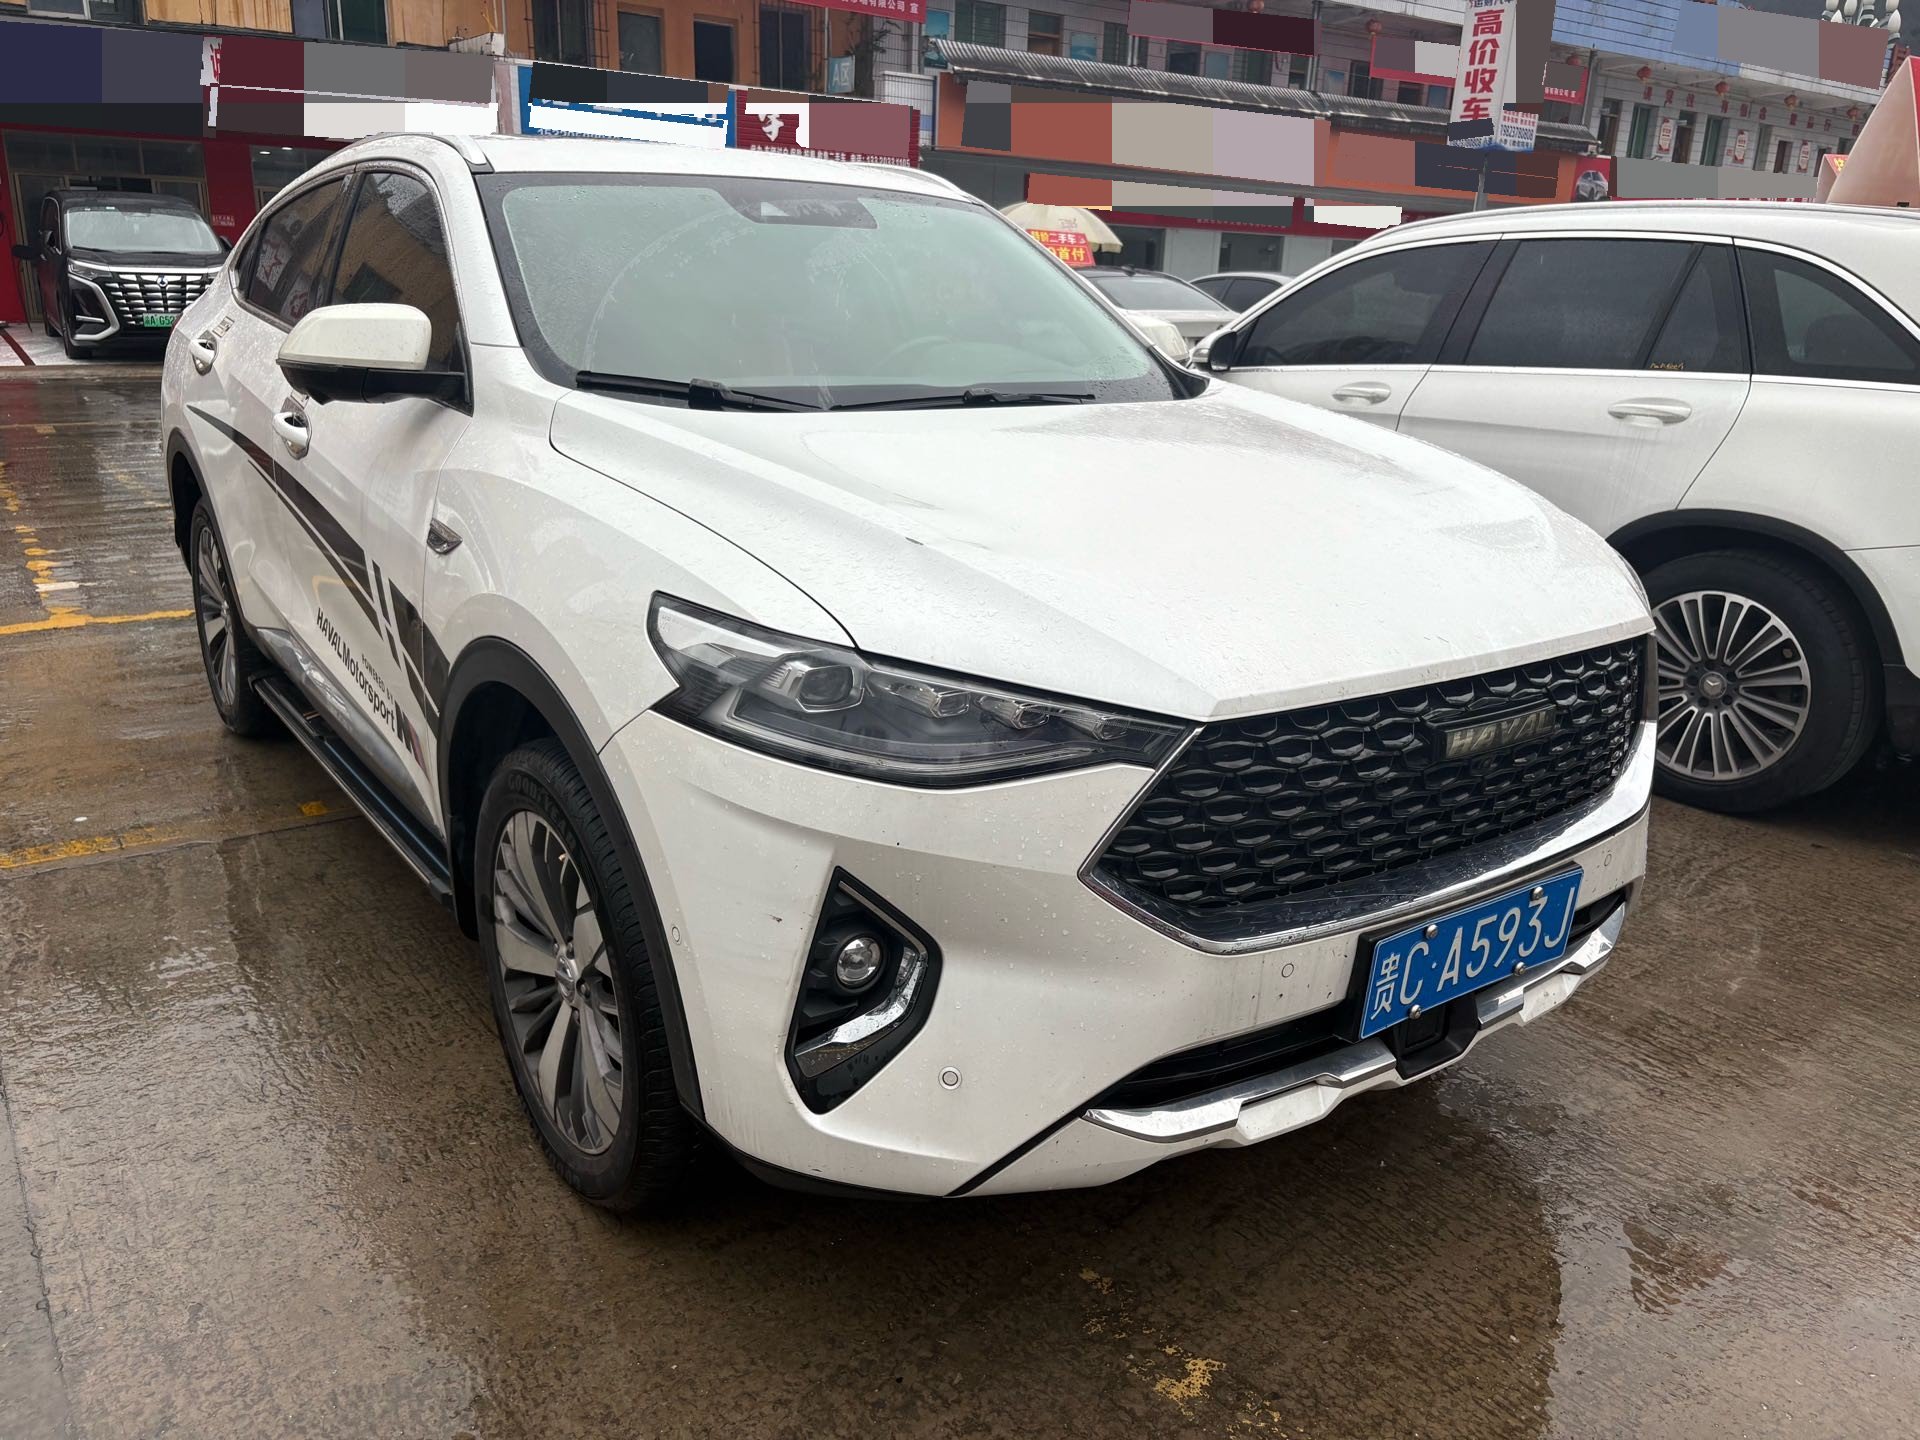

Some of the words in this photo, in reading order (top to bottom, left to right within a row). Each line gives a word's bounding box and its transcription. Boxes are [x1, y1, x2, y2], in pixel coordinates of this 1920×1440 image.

[832, 62, 851, 86] A区
[1460, 9, 1504, 120] 高价收车
[1450, 709, 1553, 755] HAVAL
